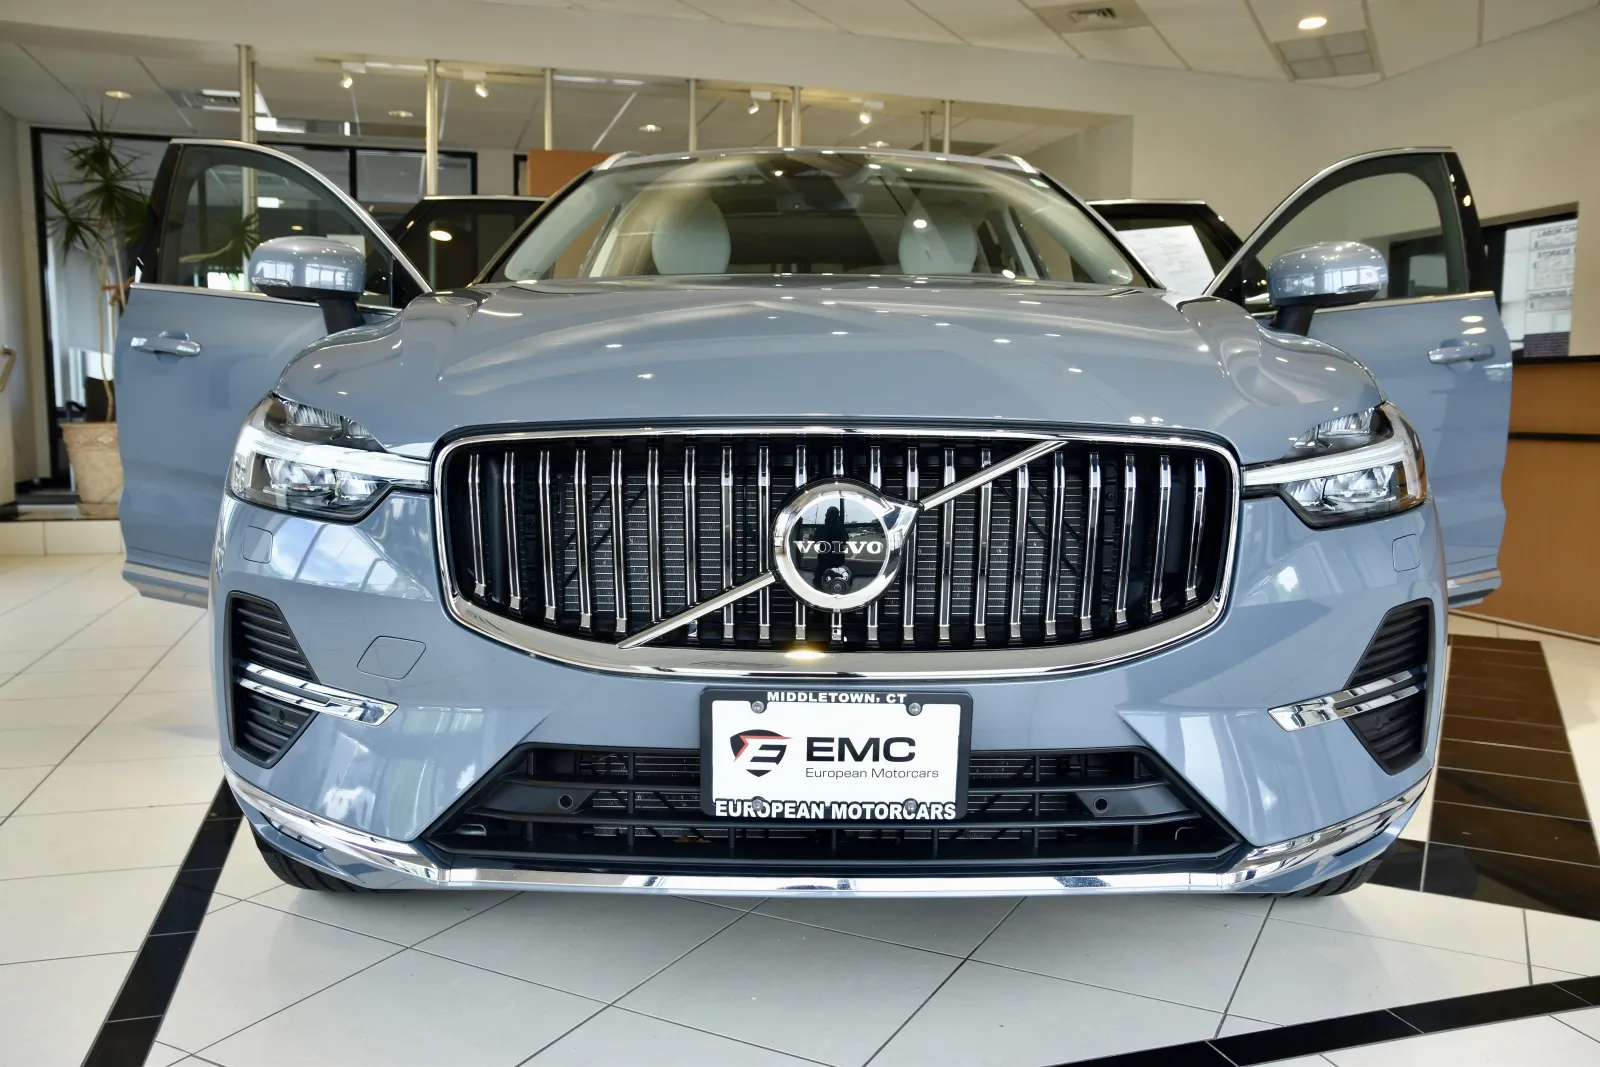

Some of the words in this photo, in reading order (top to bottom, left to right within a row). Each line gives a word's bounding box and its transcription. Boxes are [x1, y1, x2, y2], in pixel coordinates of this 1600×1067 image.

[1537, 228, 1562, 238] LABOR
[1537, 248, 1571, 259] STORAGE
[793, 540, 884, 555] VOLVO
[767, 691, 880, 703] MIDDLETOWN,
[886, 693, 907, 704] CT
[806, 736, 916, 762] EMC
[805, 767, 867, 780] European
[871, 767, 939, 779] Motorcars
[715, 800, 825, 819] EUROPEAN
[831, 802, 956, 820] MOTORCARS
